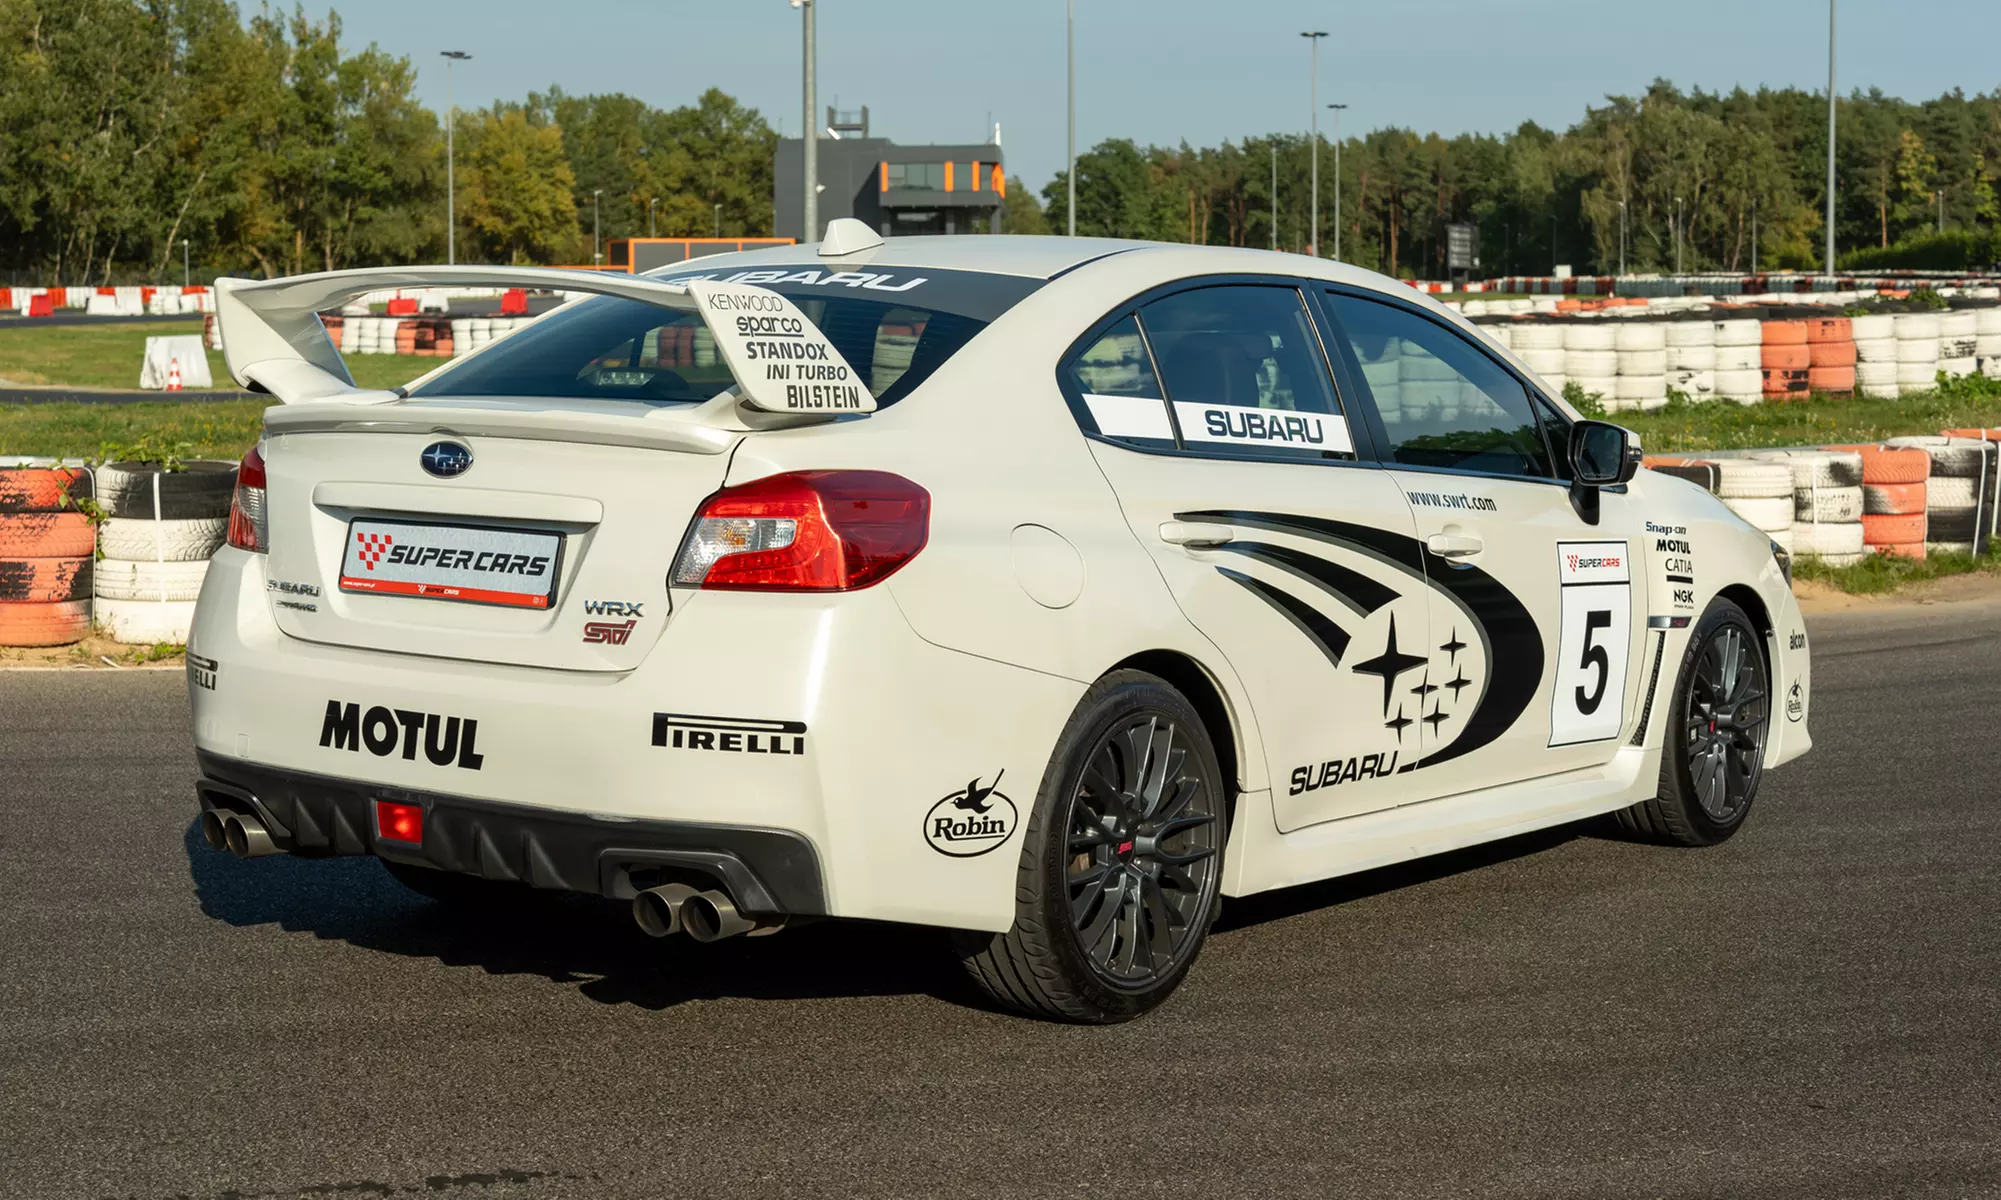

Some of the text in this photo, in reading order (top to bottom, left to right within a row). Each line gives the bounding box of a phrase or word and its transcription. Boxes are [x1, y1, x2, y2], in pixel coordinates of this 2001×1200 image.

[707, 293, 784, 312] KENWOOD
[736, 315, 804, 337] sparco
[746, 341, 829, 360] STANDOX
[766, 364, 848, 381] INI TURBO
[786, 384, 860, 409] BILSTEIN
[1205, 410, 1323, 444] SUBARU
[1407, 490, 1497, 512] www.swrt.com
[1645, 521, 1687, 535] Snap-on
[1656, 539, 1691, 554] MOTUL
[1665, 558, 1693, 574] CATIA
[1674, 589, 1694, 604] NGK
[584, 600, 644, 618] WRX
[1575, 609, 1612, 716] 5
[319, 700, 485, 771] MOTUL
[651, 712, 807, 756] PIRELLI
[1289, 750, 1398, 796] SUBARU
[932, 815, 1006, 841] Robin
